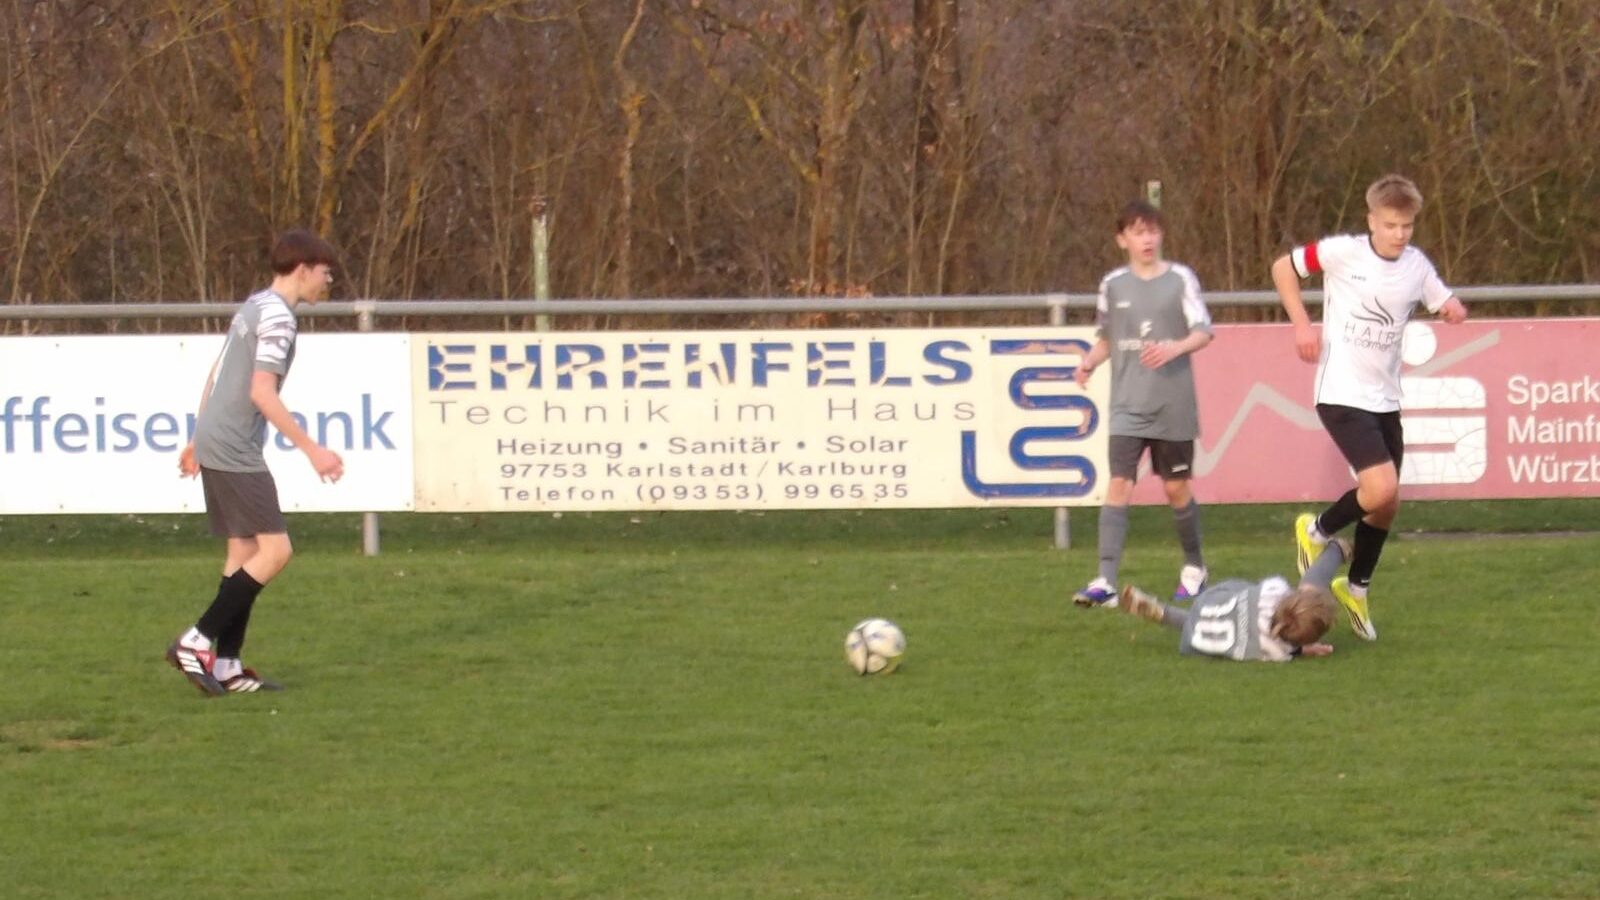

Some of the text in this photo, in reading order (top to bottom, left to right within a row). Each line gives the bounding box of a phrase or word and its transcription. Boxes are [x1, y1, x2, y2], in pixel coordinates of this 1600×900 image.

[1344, 321, 1396, 344] HAIR
[427, 340, 973, 391] EHRENFELS
[1507, 375, 1600, 411] Spark
[430, 398, 976, 425] Technik im Haus
[497, 436, 909, 459] Heizung Sanitär Solar
[500, 463, 588, 478] 97753
[501, 486, 615, 501] Telefon
